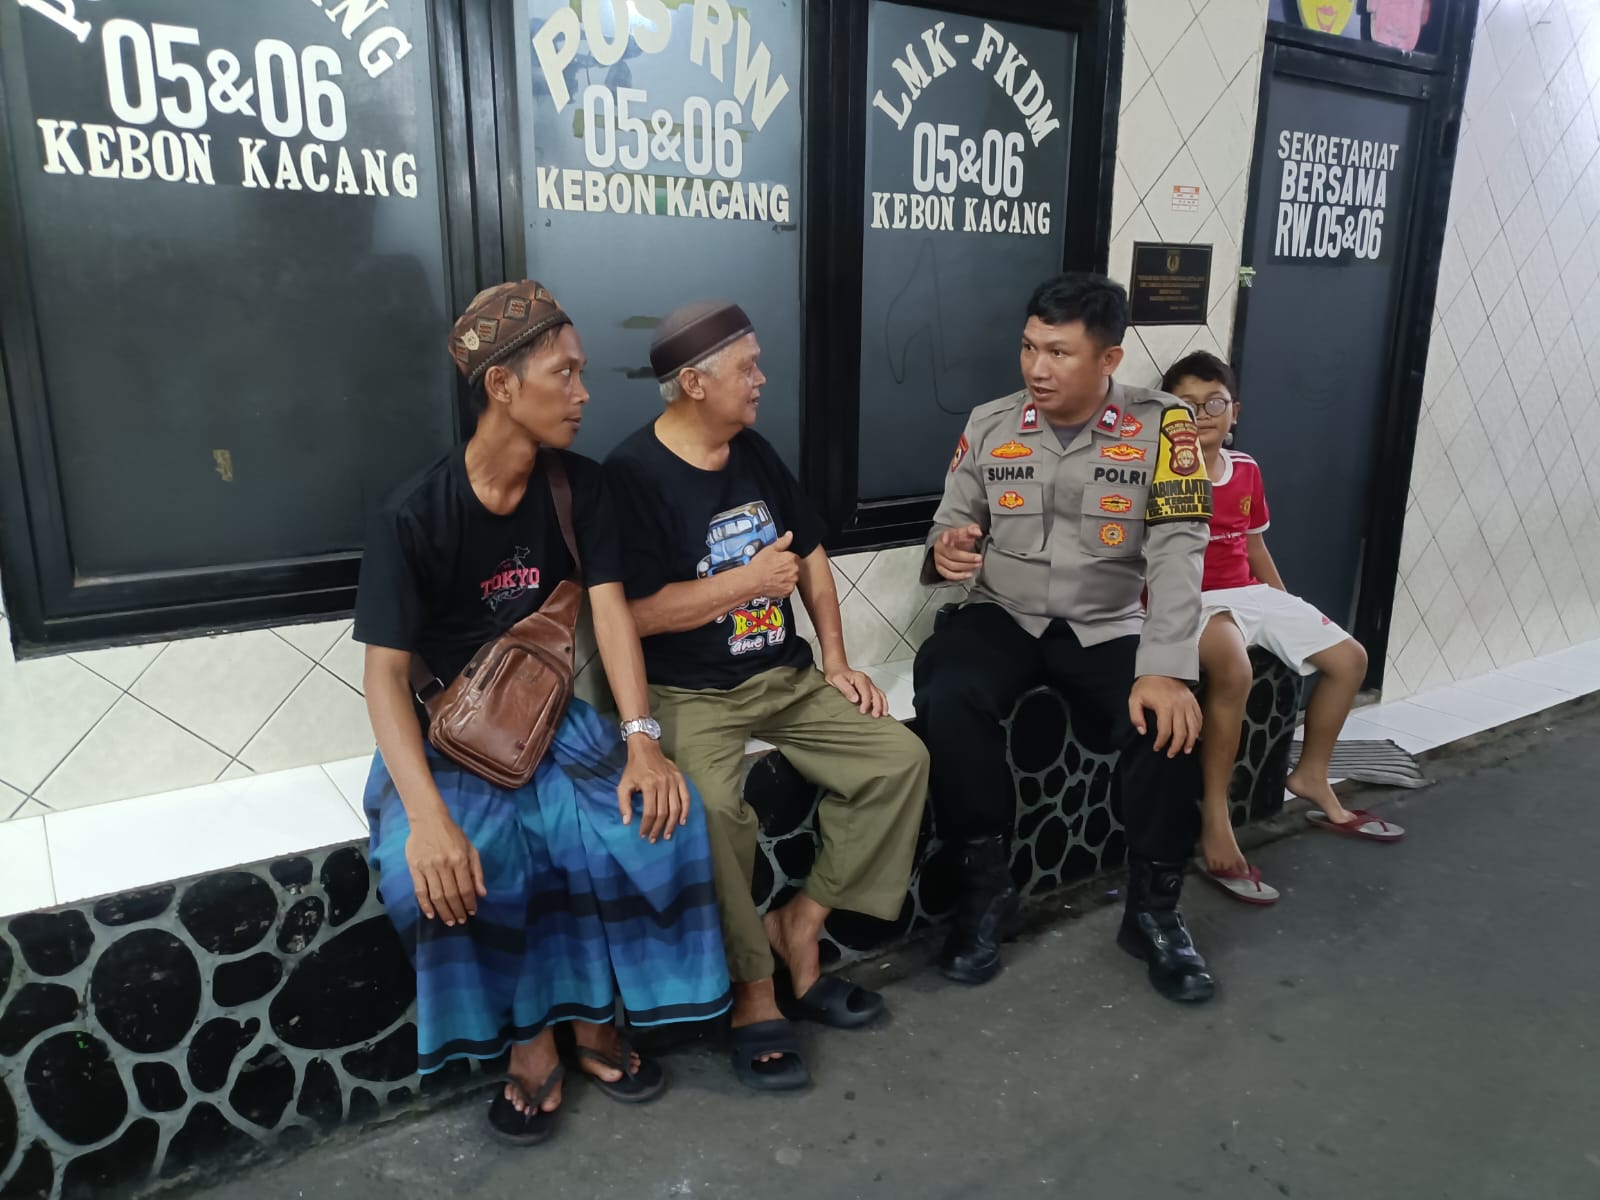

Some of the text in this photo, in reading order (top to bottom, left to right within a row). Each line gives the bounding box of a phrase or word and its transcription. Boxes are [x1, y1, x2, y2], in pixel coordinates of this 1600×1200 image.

[102, 18, 348, 142] 05&06
[532, 0, 790, 133] POS RW
[37, 118, 418, 198] KEBON KACANG
[583, 84, 743, 178] 05&06
[1277, 129, 1399, 171] SEKRETARIAT
[913, 122, 1025, 198] 05&06
[1280, 160, 1387, 208] BERSAMA
[536, 166, 790, 222] KEBON KACANG
[871, 191, 1051, 234] KEBON KACANG
[1275, 202, 1384, 260] RW.05&06
[988, 466, 1147, 486] SUHAR POLRI
[480, 567, 540, 598] TOKYO
